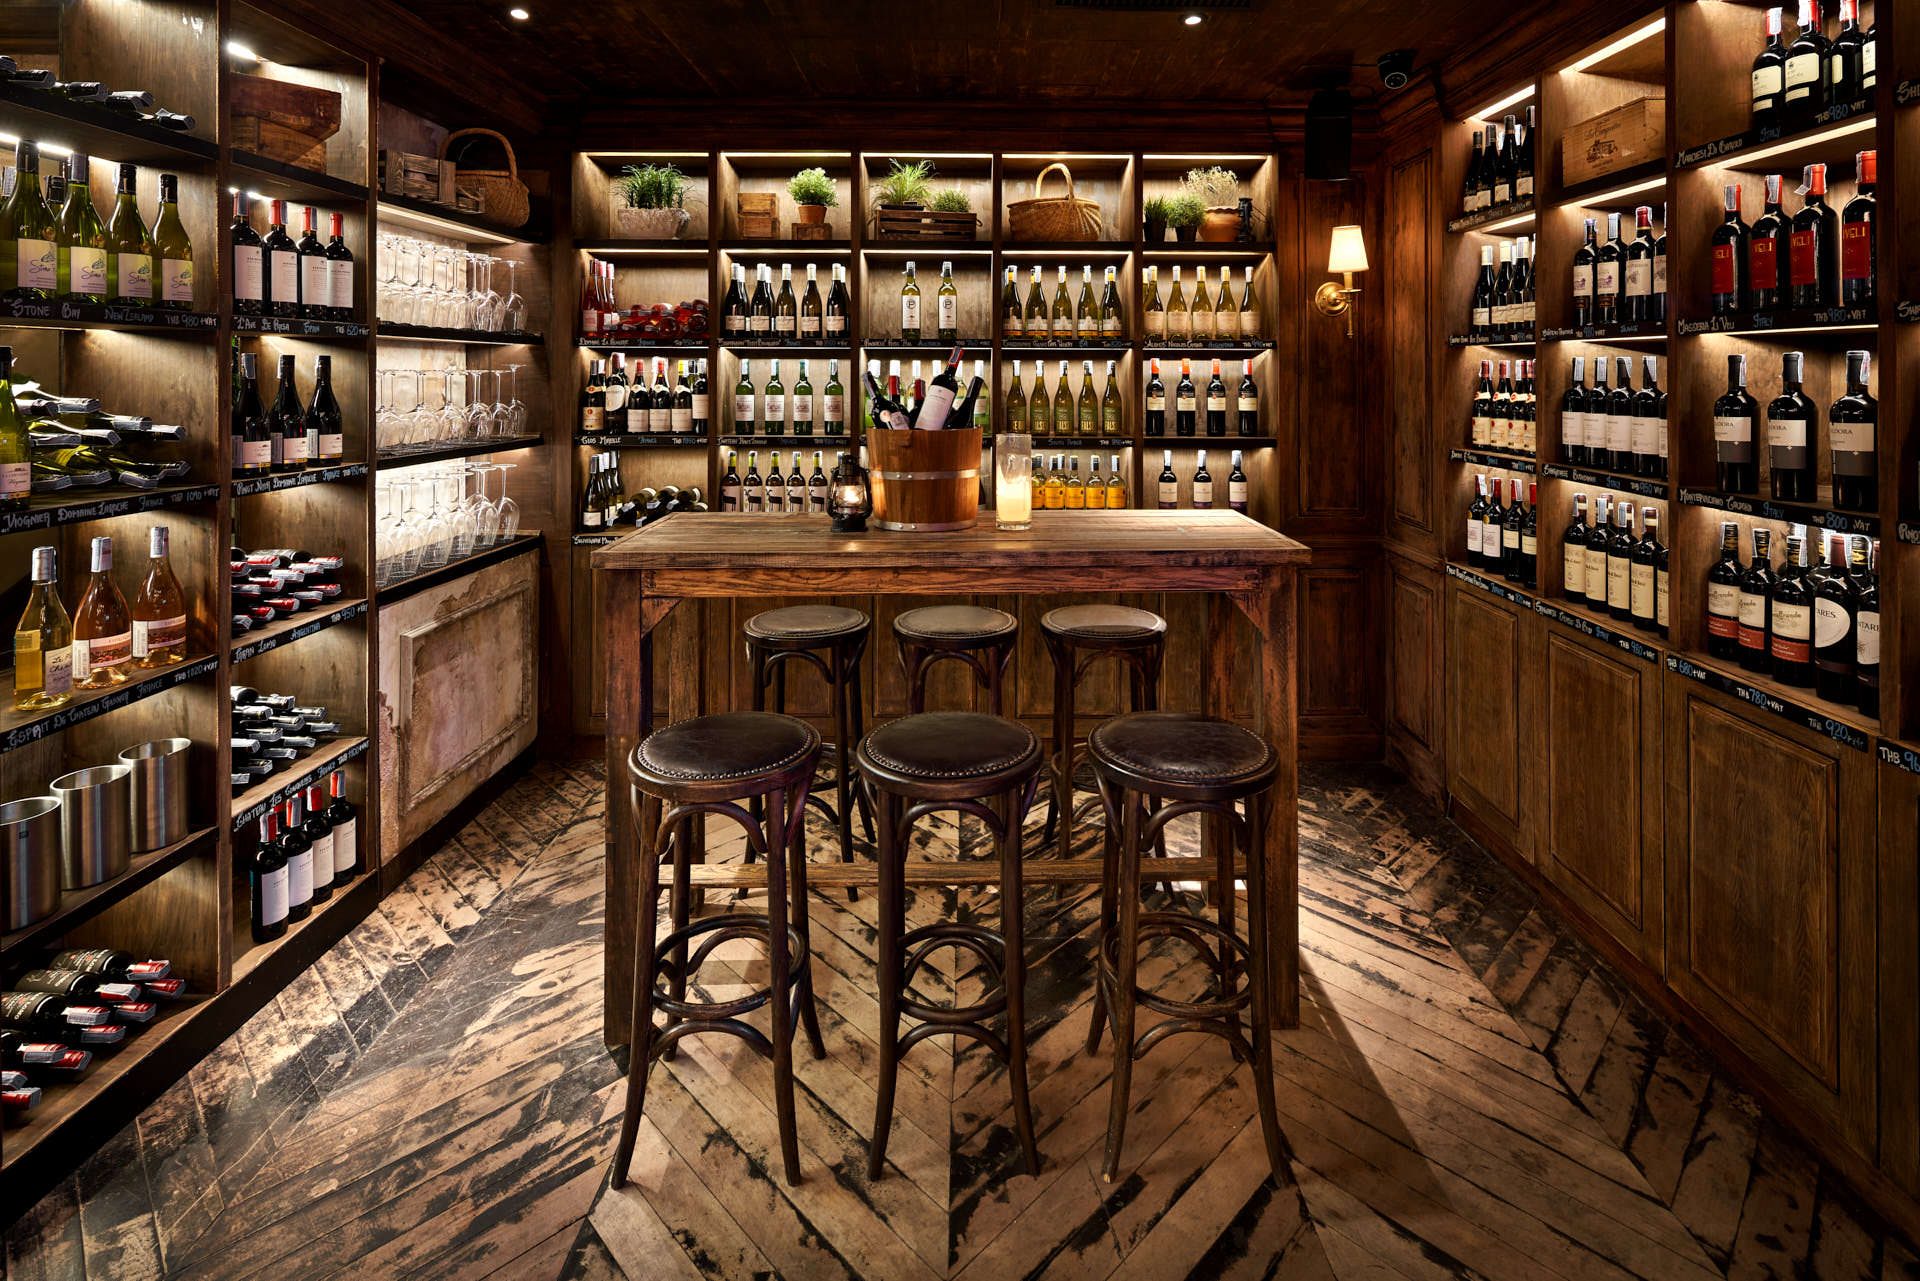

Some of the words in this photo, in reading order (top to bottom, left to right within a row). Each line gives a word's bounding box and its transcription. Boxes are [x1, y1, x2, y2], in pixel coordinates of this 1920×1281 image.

[1748, 687, 1767, 707] 780
[1825, 719, 1849, 740] 920
[1879, 746, 1901, 764] THB
